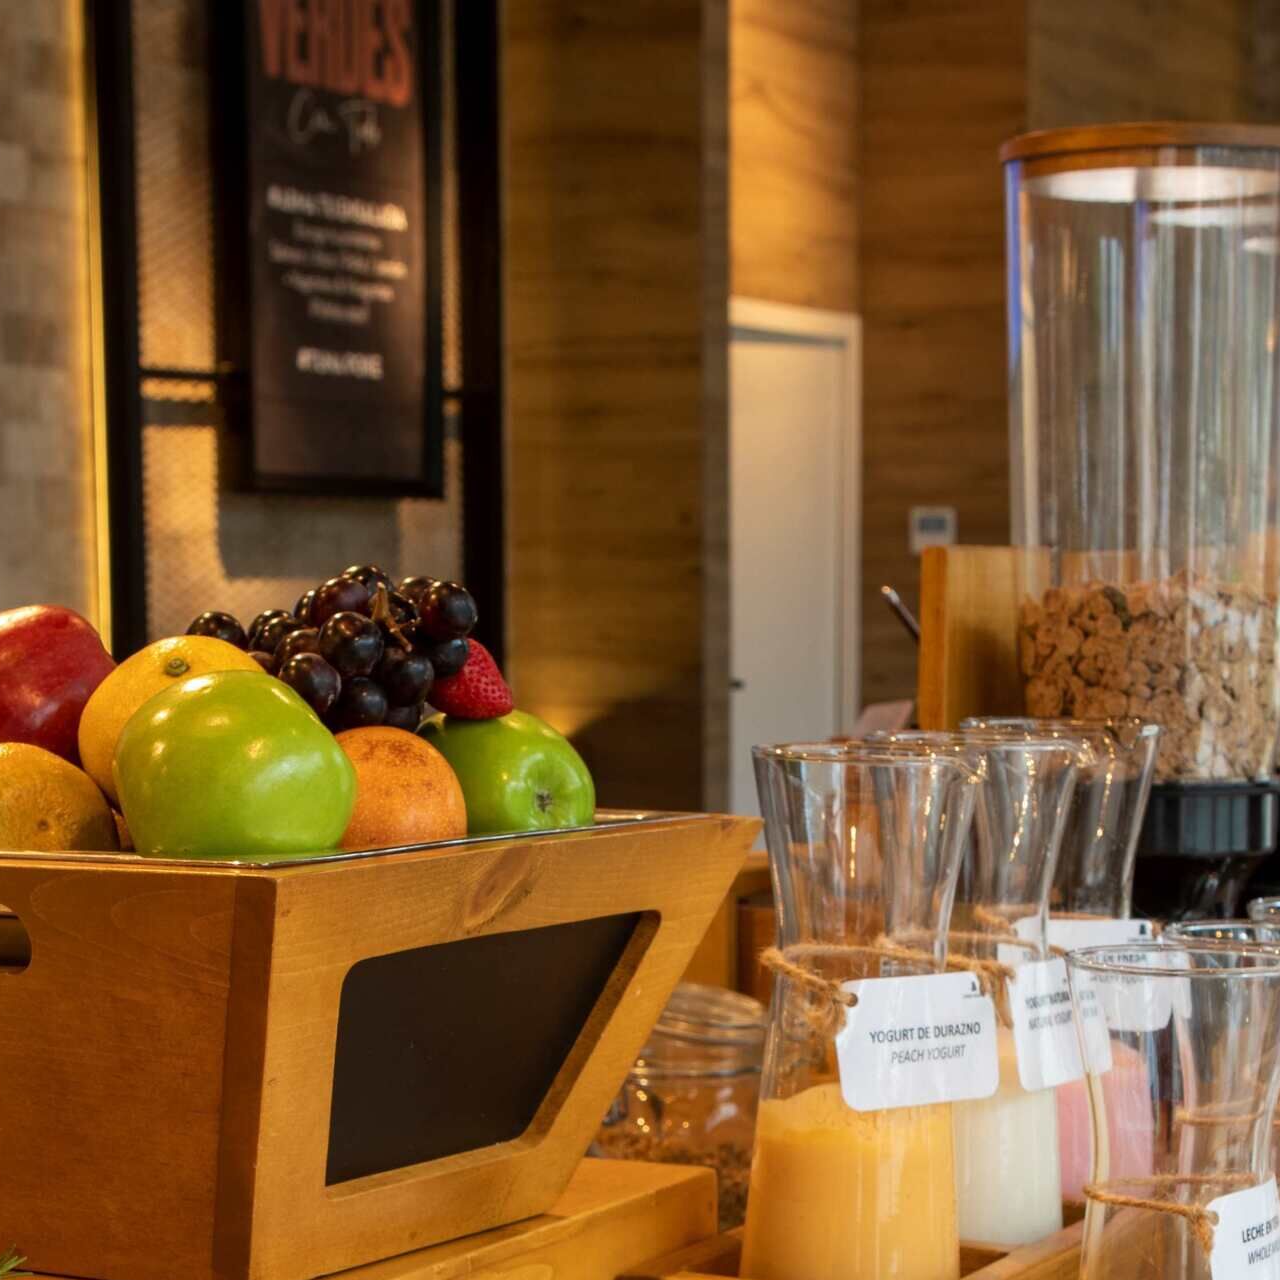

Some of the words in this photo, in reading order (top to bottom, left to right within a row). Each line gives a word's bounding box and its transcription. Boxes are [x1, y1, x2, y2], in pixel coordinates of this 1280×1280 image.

[869, 1028, 914, 1043] YOGURT
[917, 1027, 931, 1039] DE
[933, 1022, 981, 1038] DURAZNO
[891, 1050, 924, 1064] PEACH
[927, 1045, 966, 1060] YOGURT
[1241, 1222, 1264, 1243] LECHE
